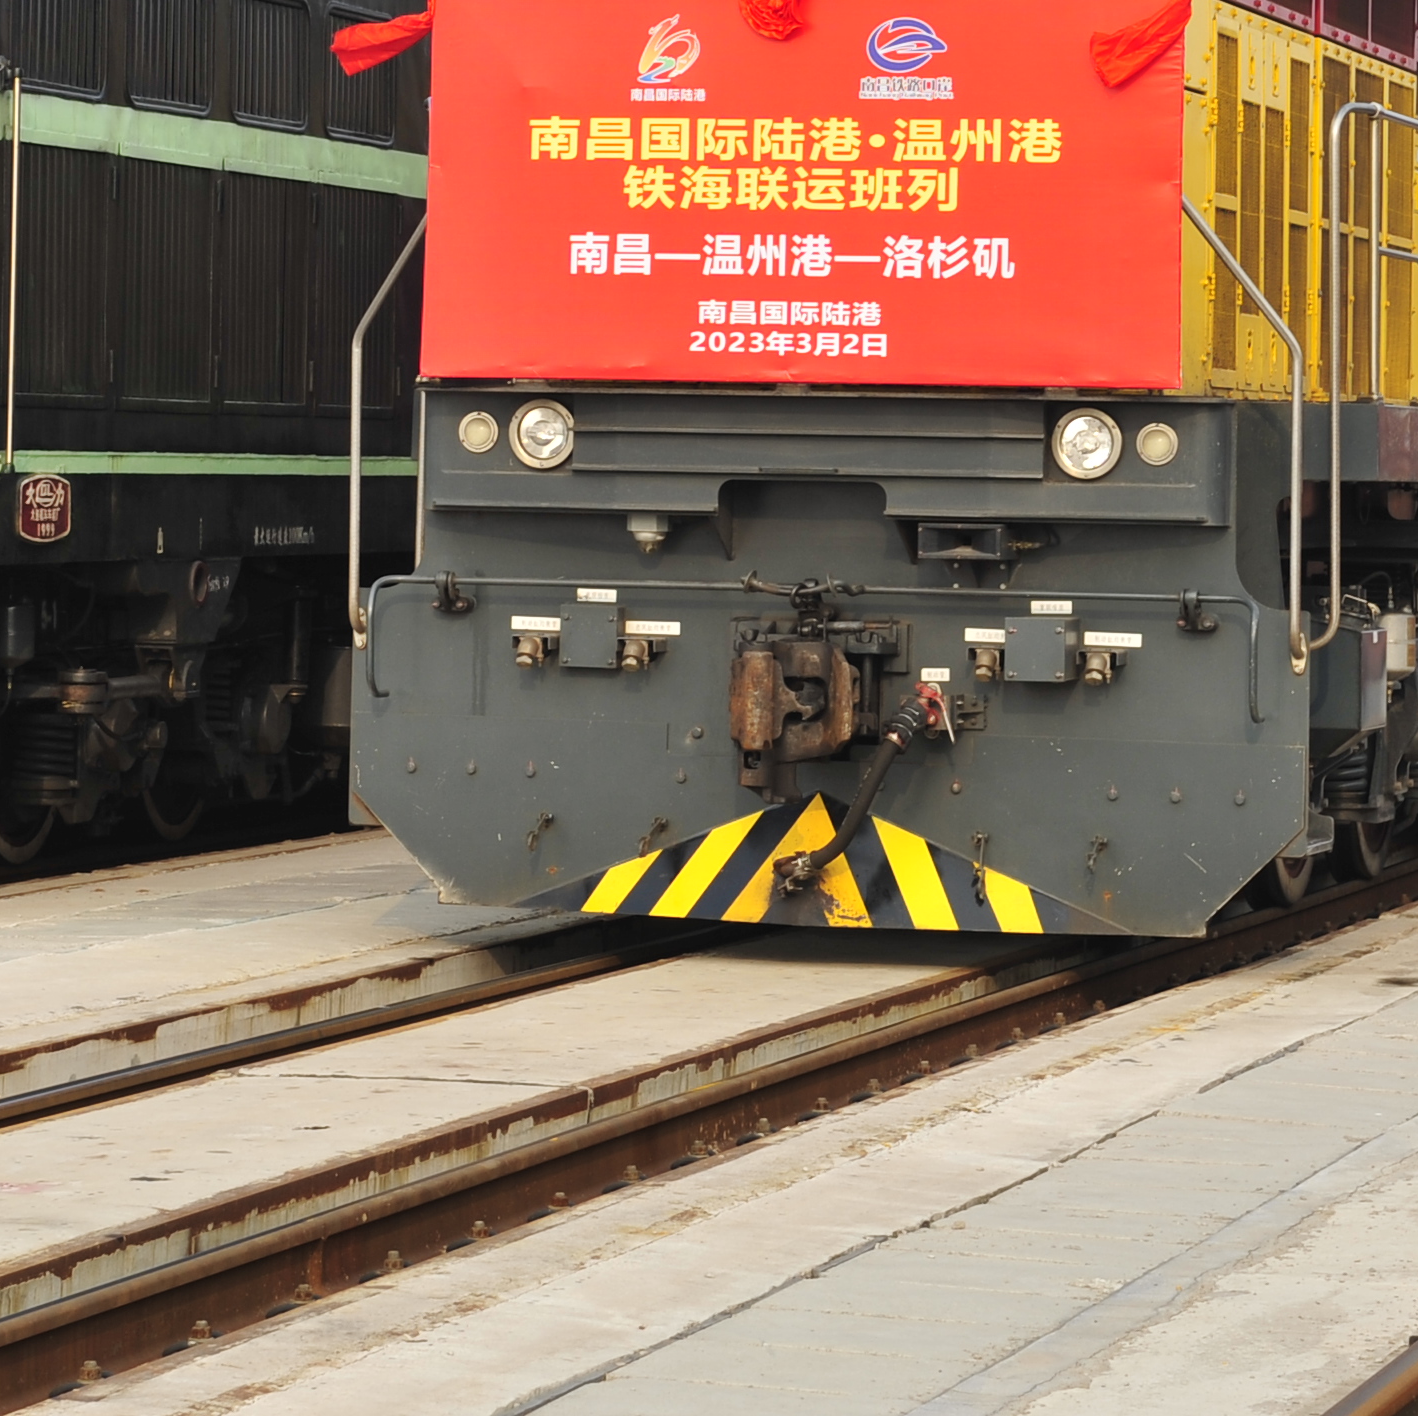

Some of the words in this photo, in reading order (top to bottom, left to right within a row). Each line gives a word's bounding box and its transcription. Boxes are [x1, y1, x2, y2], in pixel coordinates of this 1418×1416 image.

[630, 88, 706, 102] 南昌国际陆港
[860, 77, 952, 92] 南昌铁路口岸
[623, 166, 959, 212] 铁海联运班列
[697, 300, 882, 327] 南昌国际陆港
[689, 330, 888, 358] 2023年3月2日
